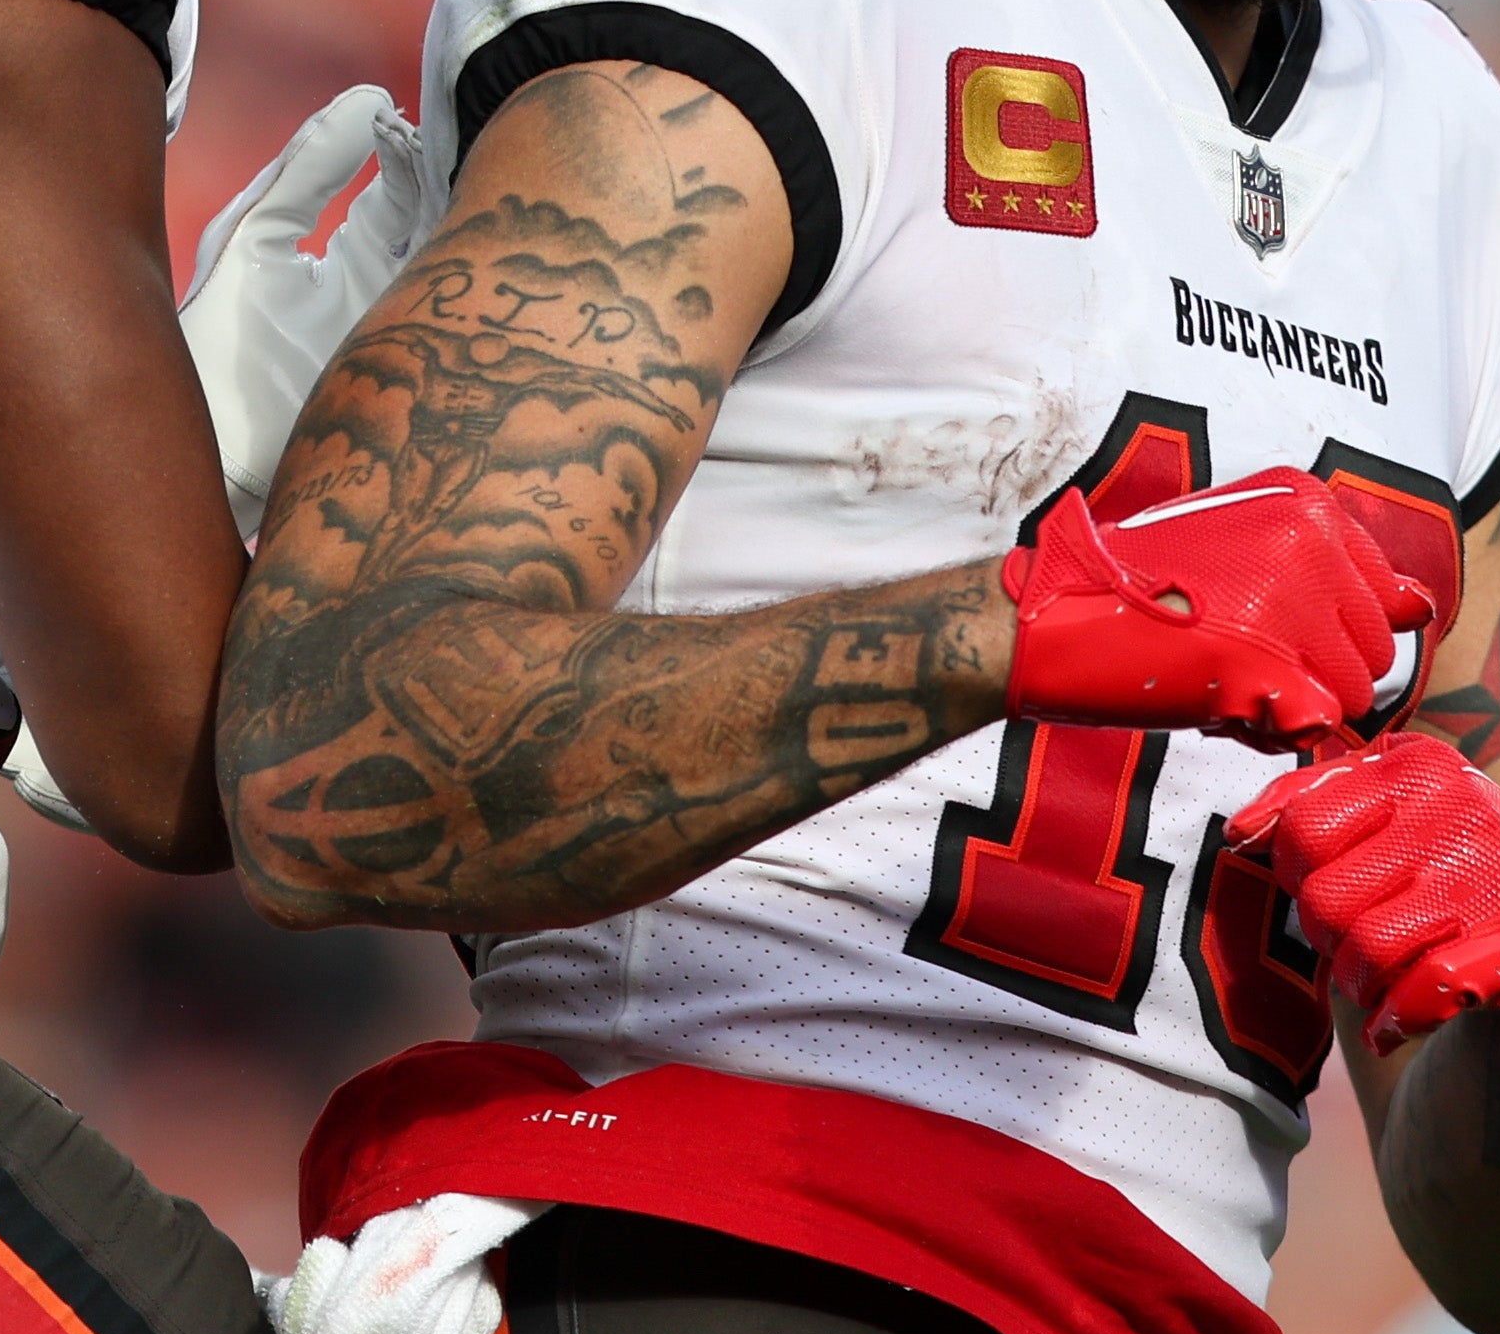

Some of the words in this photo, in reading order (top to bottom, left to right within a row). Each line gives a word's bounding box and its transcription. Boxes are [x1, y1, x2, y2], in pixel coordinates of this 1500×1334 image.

[961, 65, 1084, 188] C
[1242, 190, 1282, 239] NFL
[1169, 275, 1389, 406] BUCCANEERS
